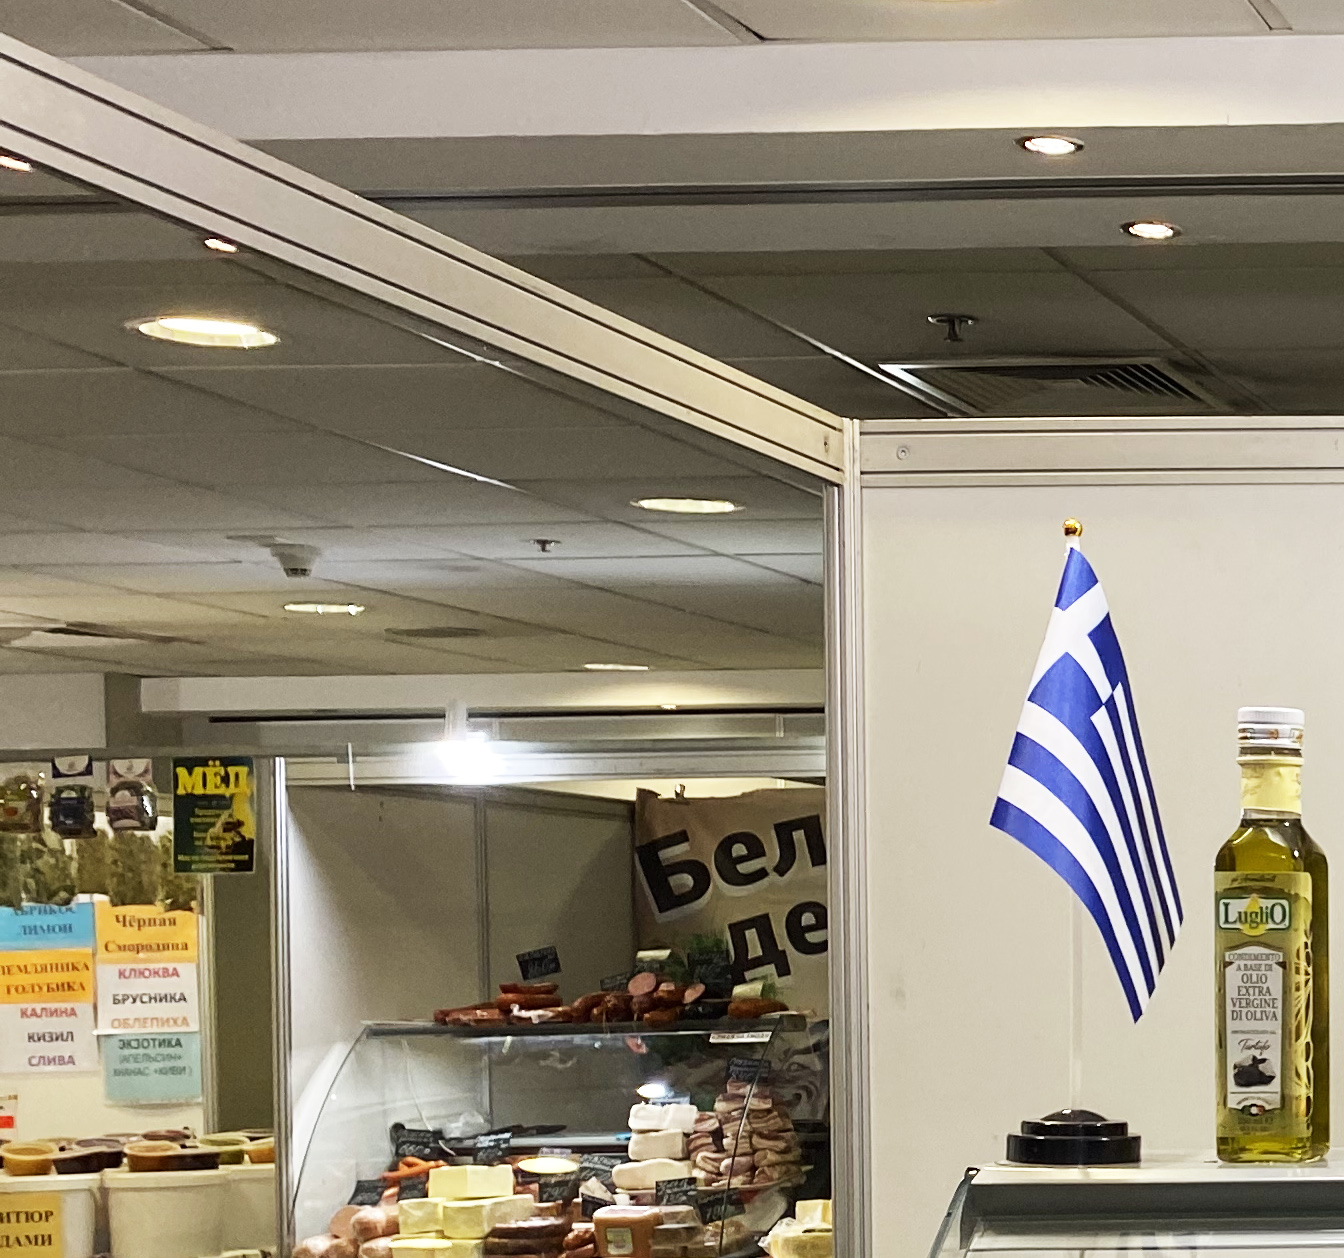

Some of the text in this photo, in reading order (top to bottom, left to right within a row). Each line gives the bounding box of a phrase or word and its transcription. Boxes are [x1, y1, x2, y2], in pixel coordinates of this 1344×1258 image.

[176, 760, 251, 796] МЁД
[114, 914, 177, 932] Чёрная
[17, 923, 73, 937] ЛИМОН
[104, 940, 189, 955] Смородина
[1228, 953, 1281, 962] CONDIMENTO
[118, 967, 180, 980] КЛЮКВА
[1241, 973, 1268, 984] OLIO
[6, 981, 86, 996] ГОЛУБИКА
[1237, 985, 1272, 997] EXTRA
[112, 992, 188, 1005] БРУСНИКА
[1231, 997, 1278, 1009] VERGINE
[20, 1006, 78, 1019] КАЛИНА
[1231, 1010, 1278, 1021] DI OLIVA
[111, 1016, 190, 1029] ОБЛЕПИХА
[27, 1031, 75, 1043] КИЗИЛ
[118, 1037, 183, 1050] ЭКЗОТИКА
[28, 1055, 76, 1067] СЛИВА
